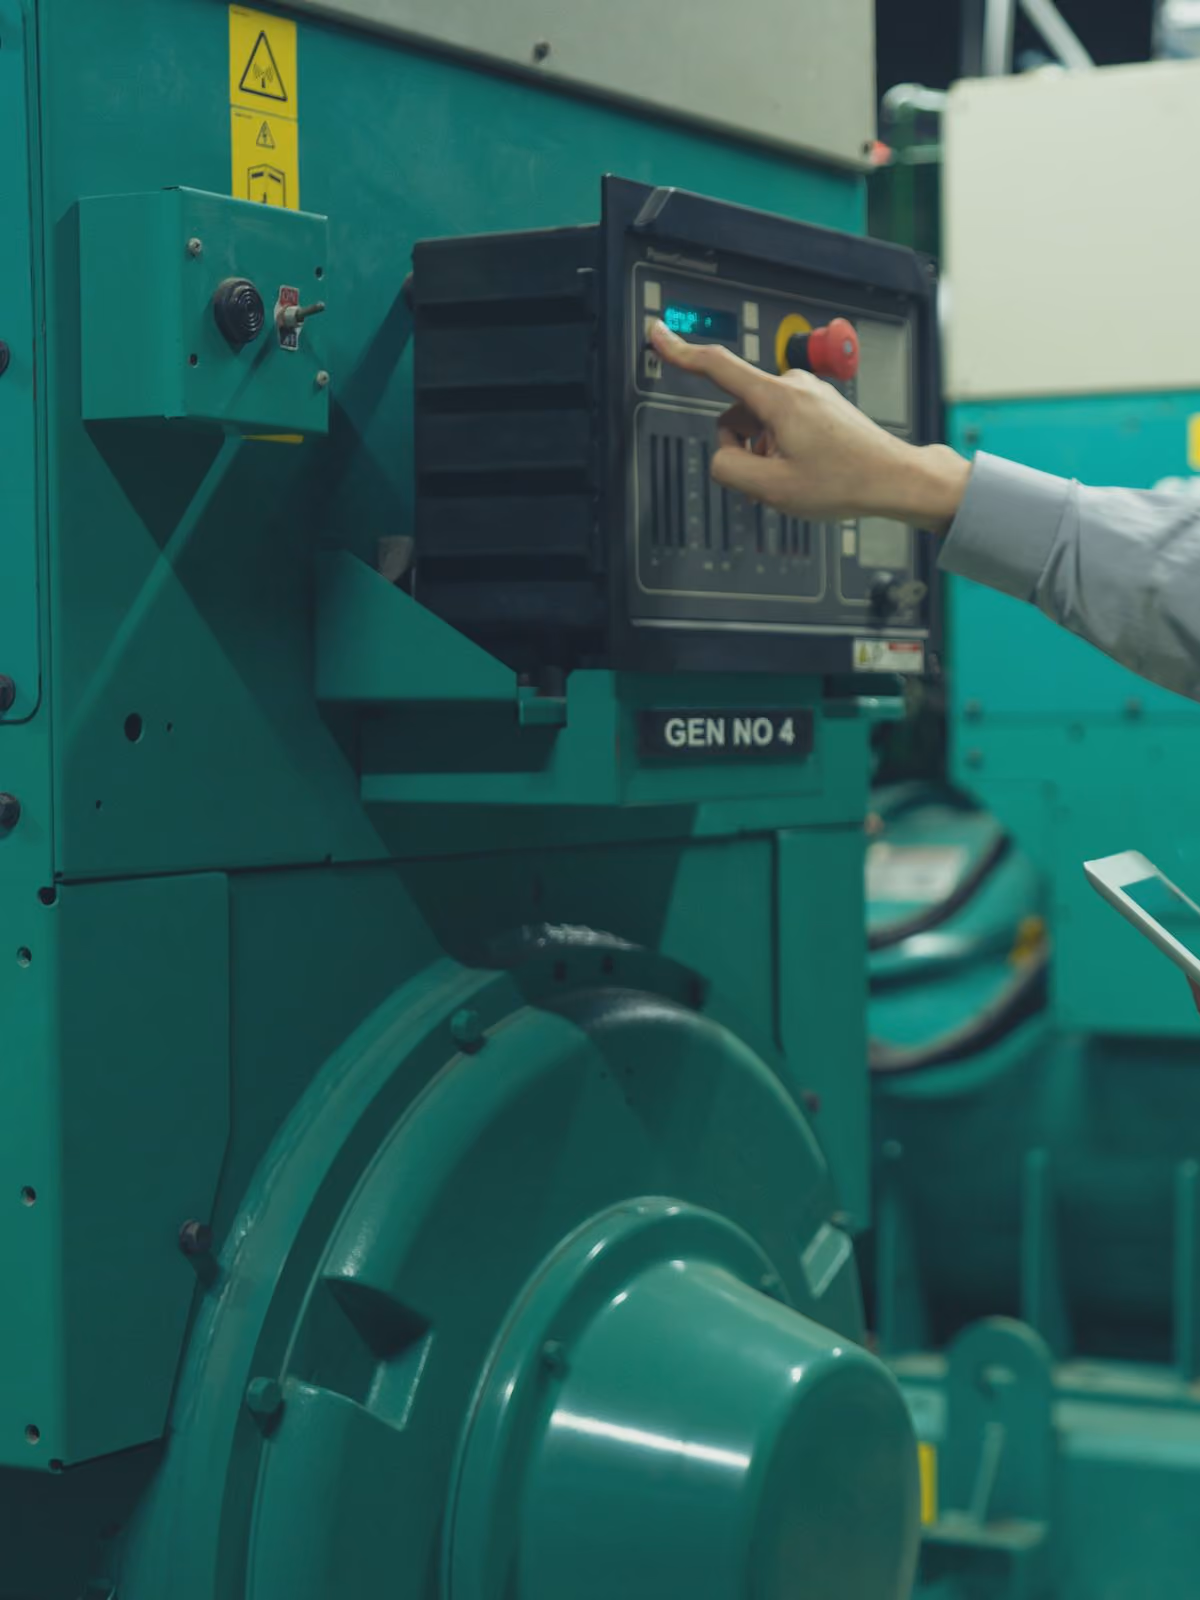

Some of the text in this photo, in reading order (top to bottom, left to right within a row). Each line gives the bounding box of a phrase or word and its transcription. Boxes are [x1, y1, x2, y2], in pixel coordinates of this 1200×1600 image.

[664, 717, 796, 747] GEN NO 4
